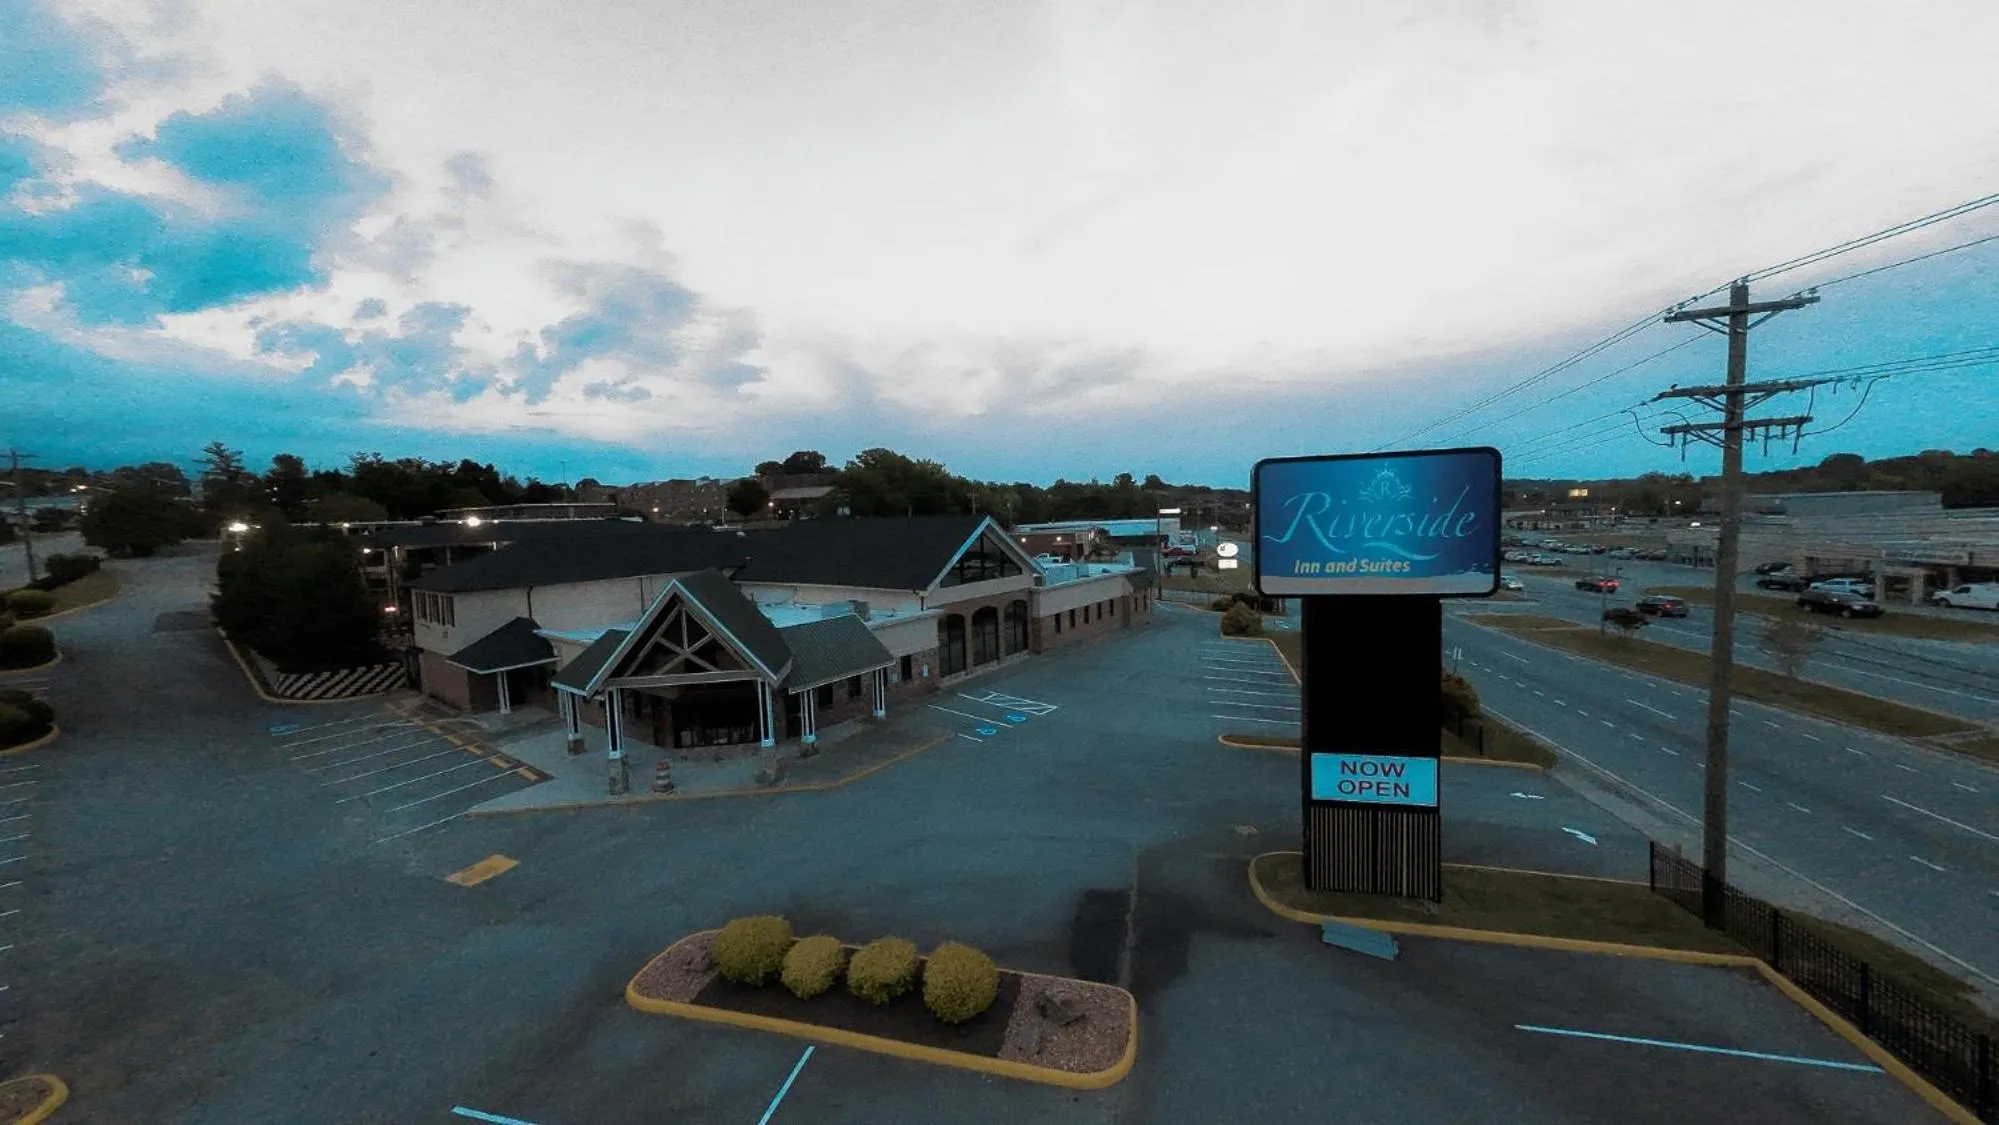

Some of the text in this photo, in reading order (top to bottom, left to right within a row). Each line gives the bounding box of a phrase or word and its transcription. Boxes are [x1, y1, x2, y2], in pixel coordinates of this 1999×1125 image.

[1381, 480, 1392, 497] R
[1263, 486, 1481, 554] Riverside
[1294, 557, 1411, 574] Inn and Suites
[1340, 760, 1406, 778] NOW
[1337, 779, 1410, 798] OPEN
